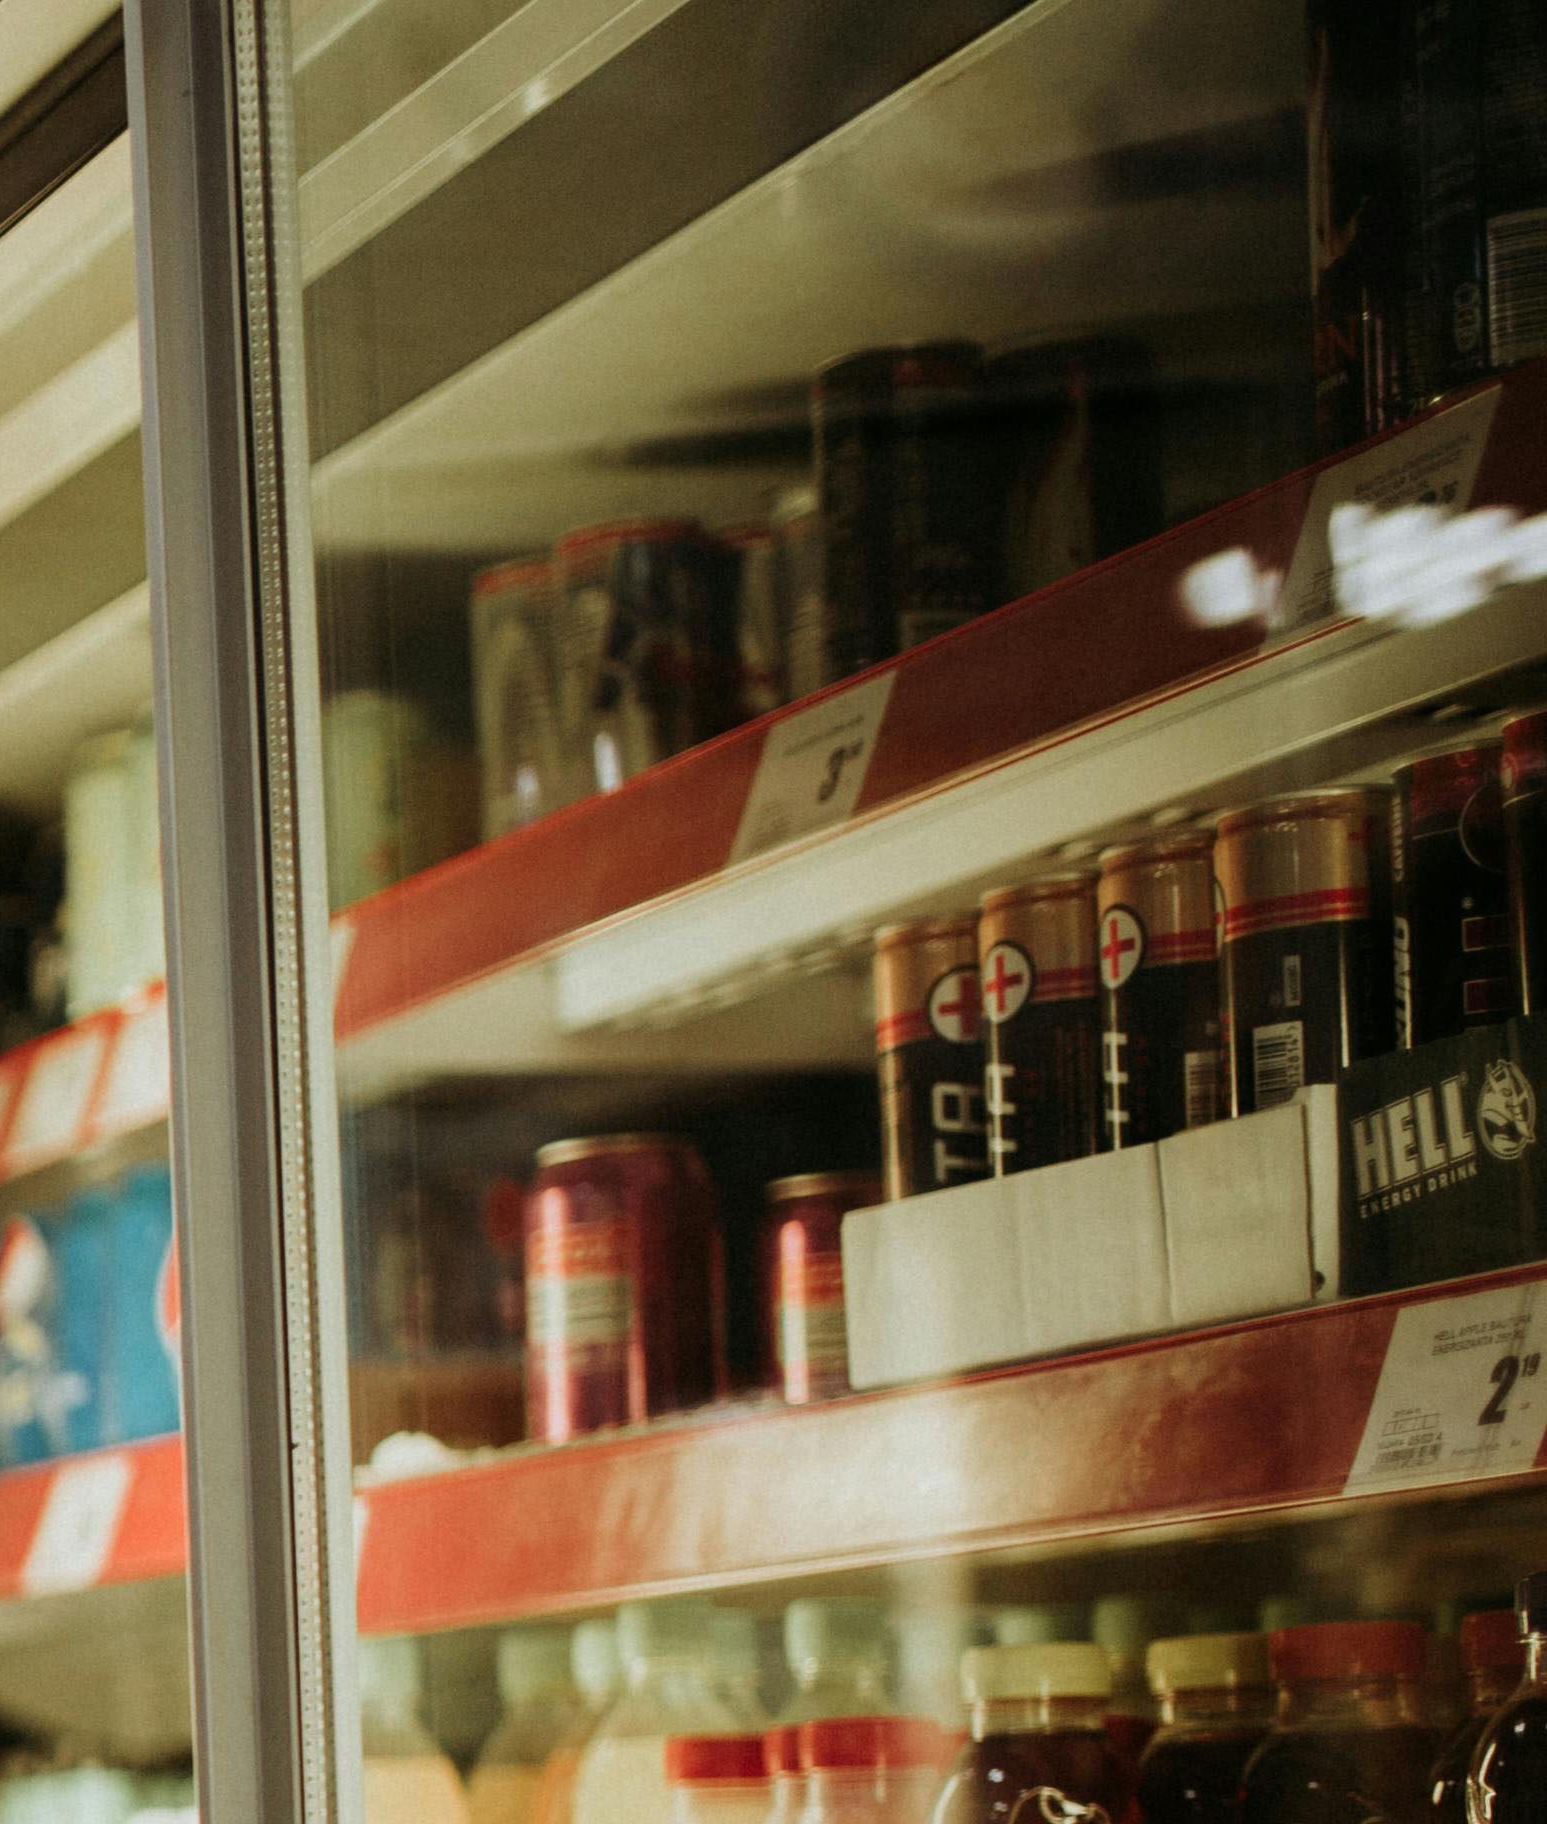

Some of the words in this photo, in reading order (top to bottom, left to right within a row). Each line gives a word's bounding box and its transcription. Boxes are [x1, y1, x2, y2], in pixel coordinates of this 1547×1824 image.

[1351, 1074, 1476, 1199] HELL
[1359, 1184, 1422, 1218] ENERGY
[1427, 1161, 1478, 1191] DRINK
[1478, 1355, 1519, 1426] 2
